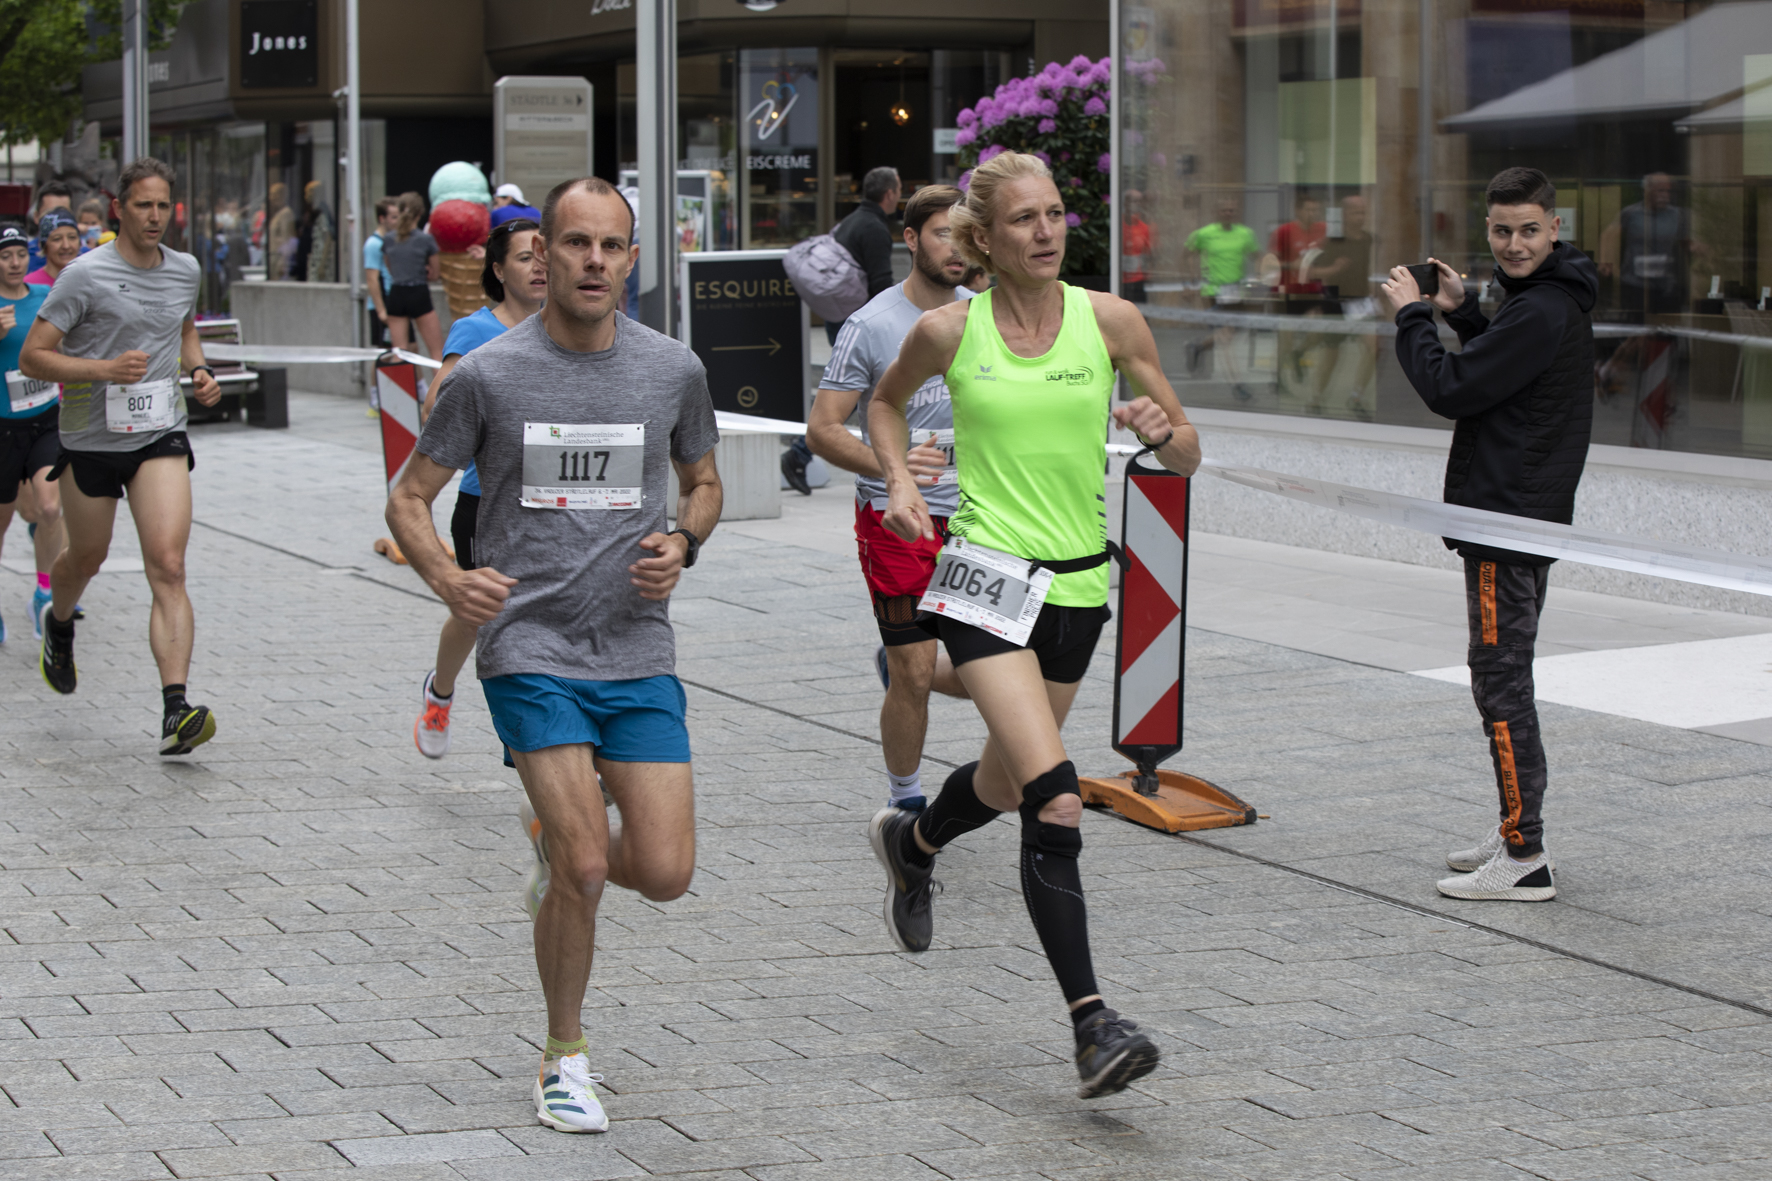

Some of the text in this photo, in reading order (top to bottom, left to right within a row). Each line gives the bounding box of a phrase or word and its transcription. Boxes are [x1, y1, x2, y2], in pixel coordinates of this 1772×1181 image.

[249, 32, 307, 55] Jones
[746, 155, 811, 169] EISCREME
[694, 278, 796, 300] ESQUIRE
[1045, 373, 1086, 382] LAUF-TREFF
[128, 395, 153, 411] 807
[558, 451, 610, 481] 1117
[939, 560, 1006, 606] 1064
[1482, 563, 1493, 592] QUAD
[1021, 591, 1038, 621] FINISHER
[1503, 770, 1518, 803] BLACK
